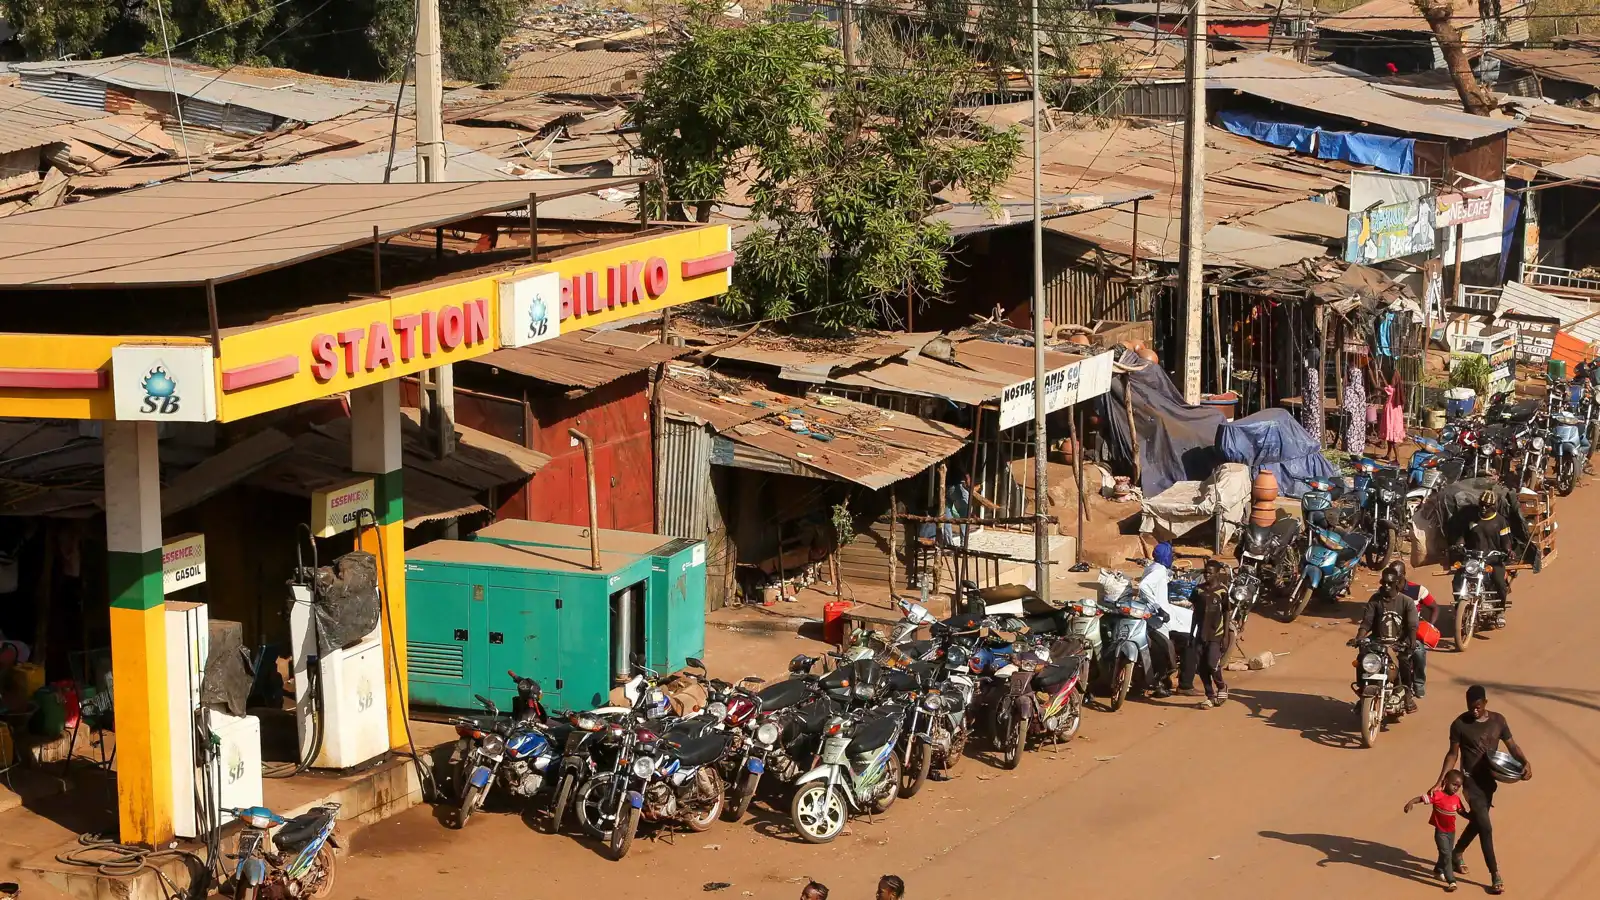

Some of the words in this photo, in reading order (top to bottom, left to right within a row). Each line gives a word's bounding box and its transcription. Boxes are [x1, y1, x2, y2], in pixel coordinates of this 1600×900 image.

[310, 299, 489, 380] STATION
[559, 256, 668, 320] BILIKO
[527, 317, 548, 340] SB
[140, 395, 181, 414] SB
[331, 491, 361, 508] ESSENCE
[343, 509, 368, 524] GASIL
[356, 692, 373, 713] SB
[228, 760, 245, 785] SB
